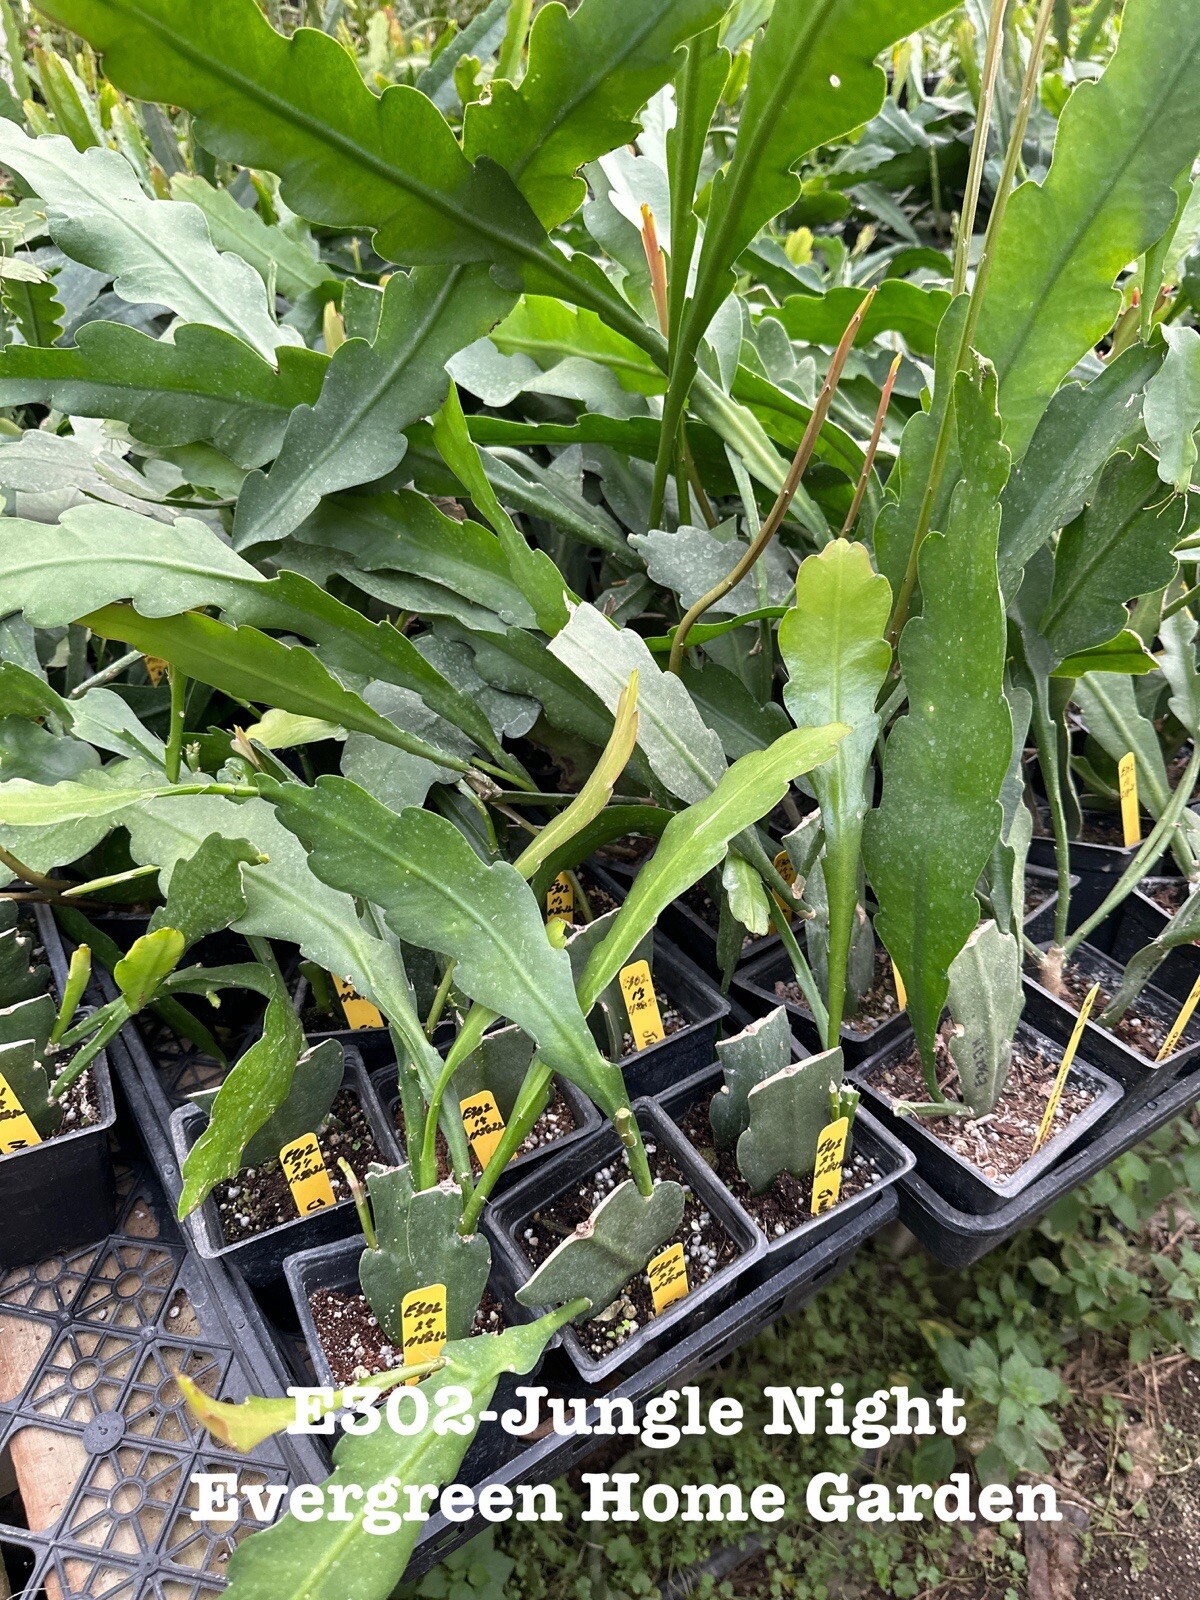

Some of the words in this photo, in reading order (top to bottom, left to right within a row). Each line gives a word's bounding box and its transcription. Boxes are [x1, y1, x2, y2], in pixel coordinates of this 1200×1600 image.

[462, 1103, 493, 1120] E302
[283, 1143, 318, 1165] E302
[404, 1301, 443, 1318] E302
